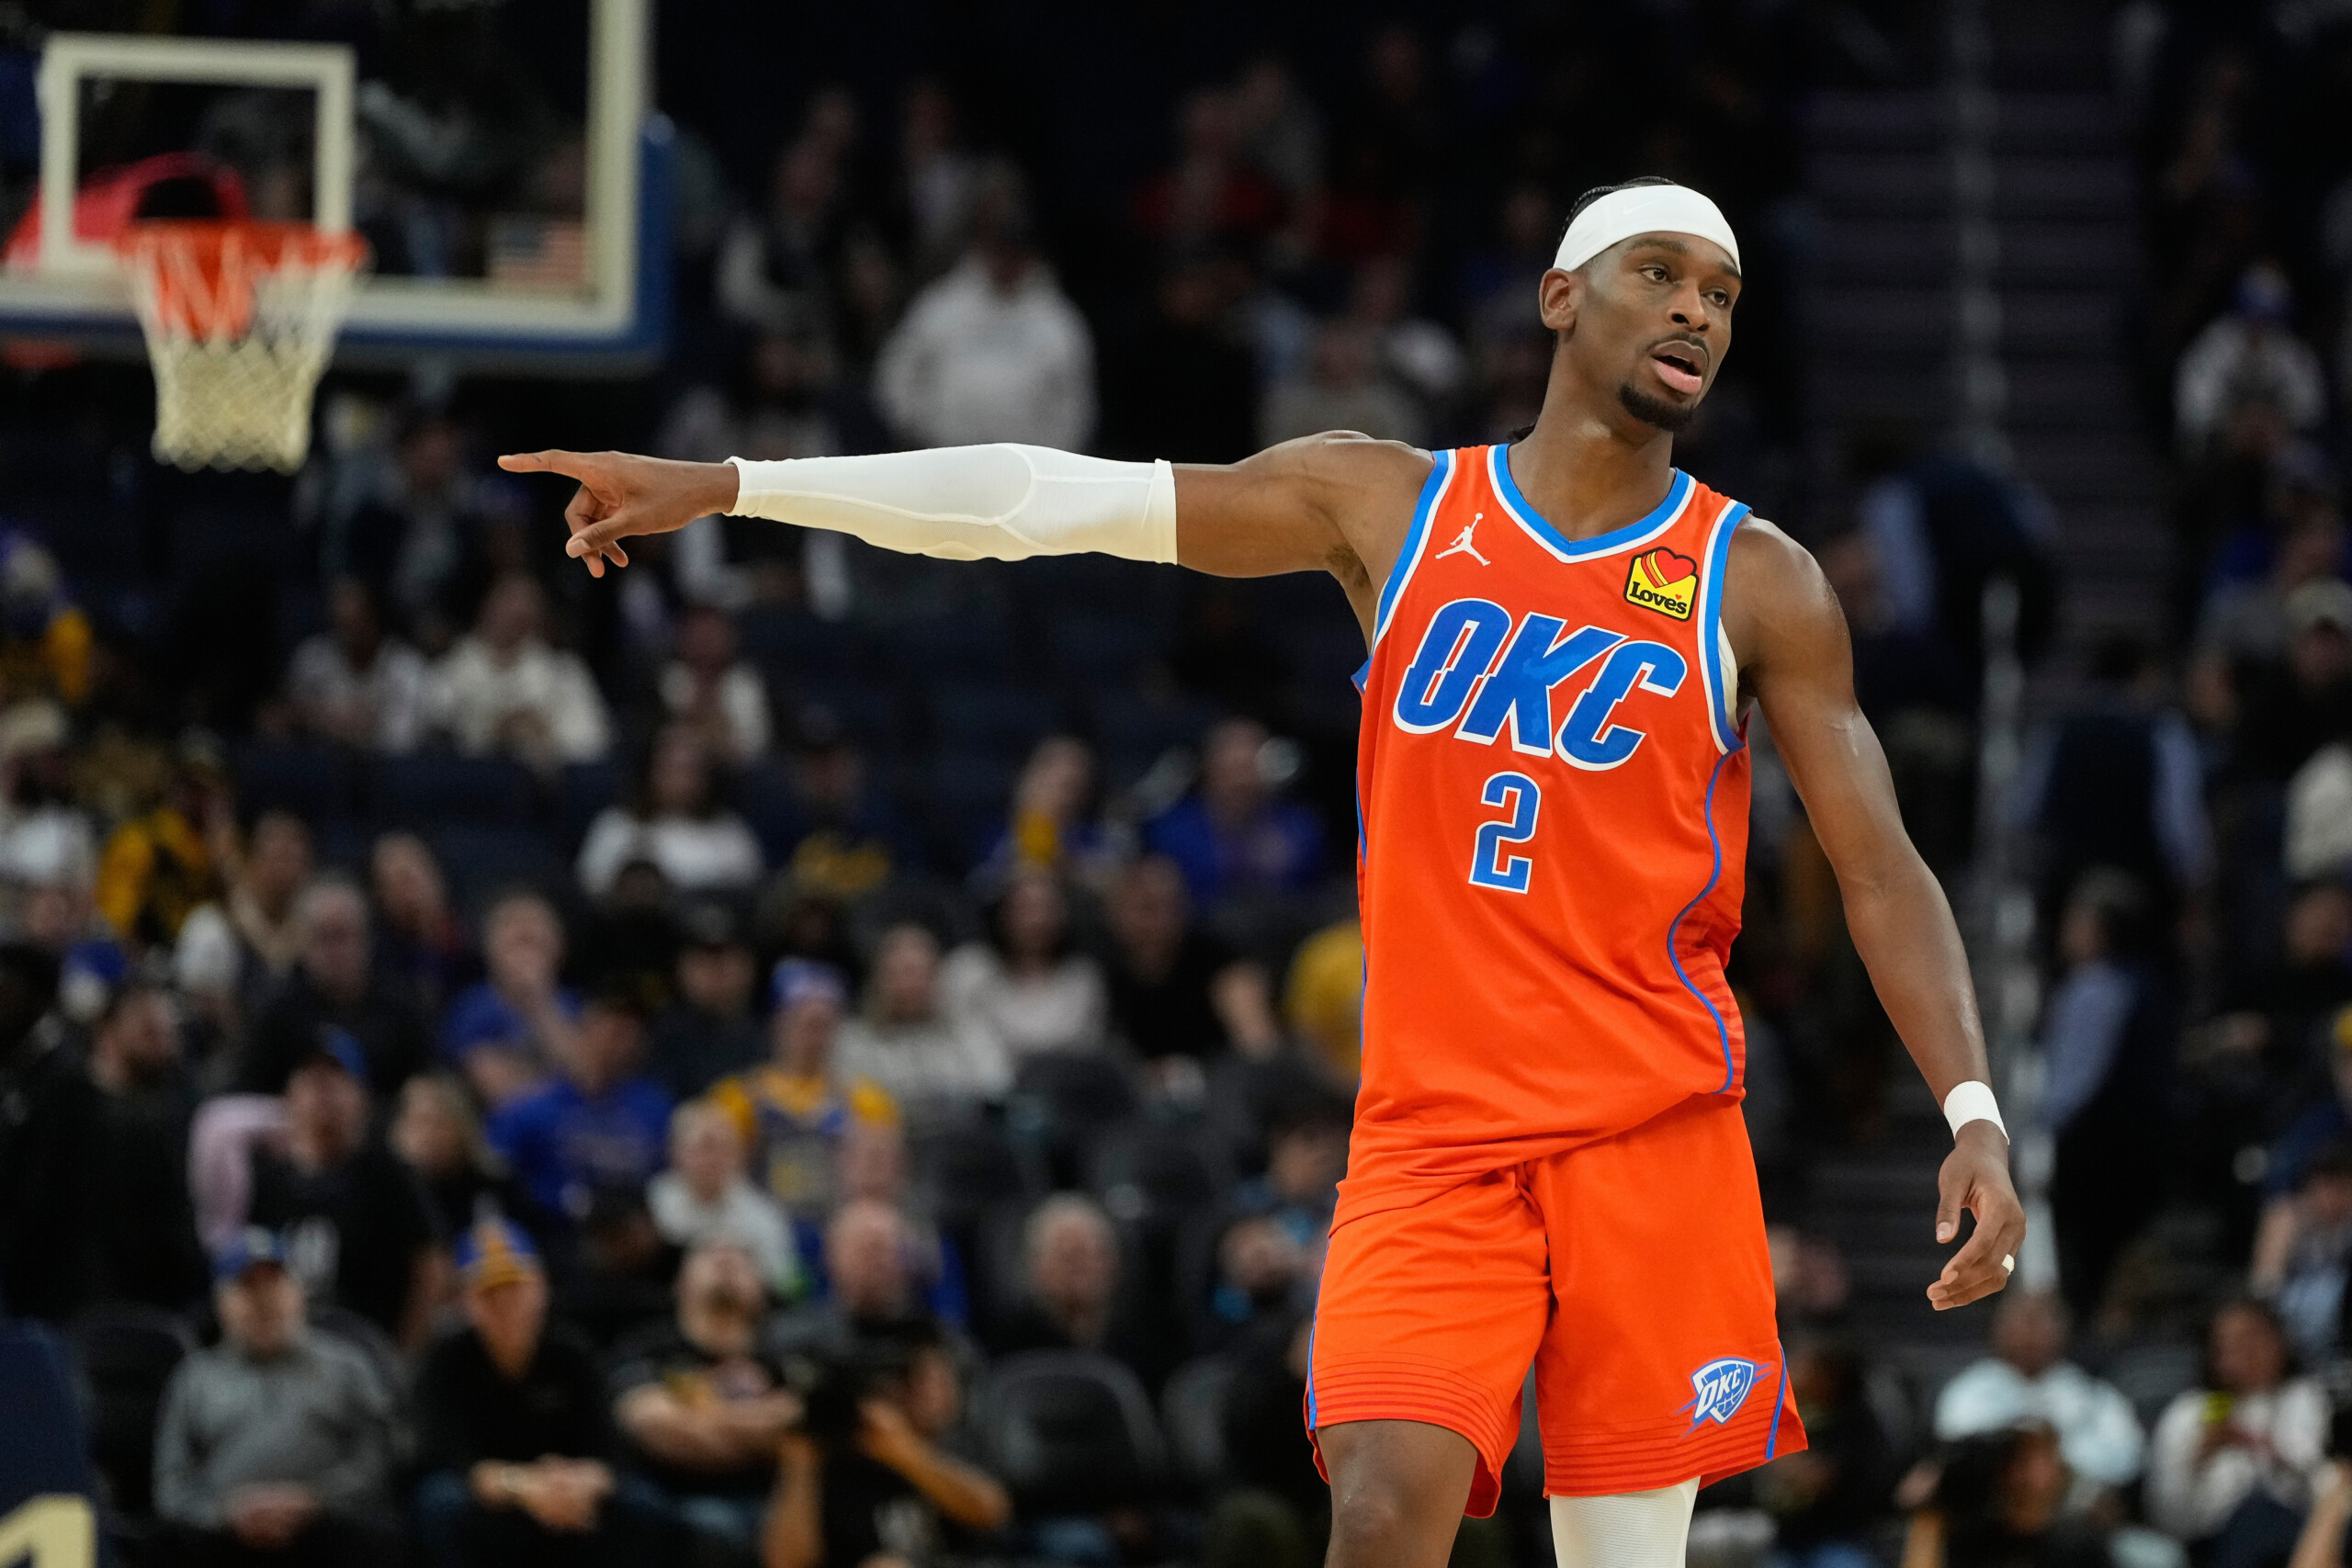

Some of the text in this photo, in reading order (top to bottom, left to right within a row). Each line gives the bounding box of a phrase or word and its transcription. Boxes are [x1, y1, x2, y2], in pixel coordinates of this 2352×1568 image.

[1393, 598, 1688, 771] OKC
[1469, 771, 1541, 894] 2
[1695, 1369, 1741, 1419] OKC
